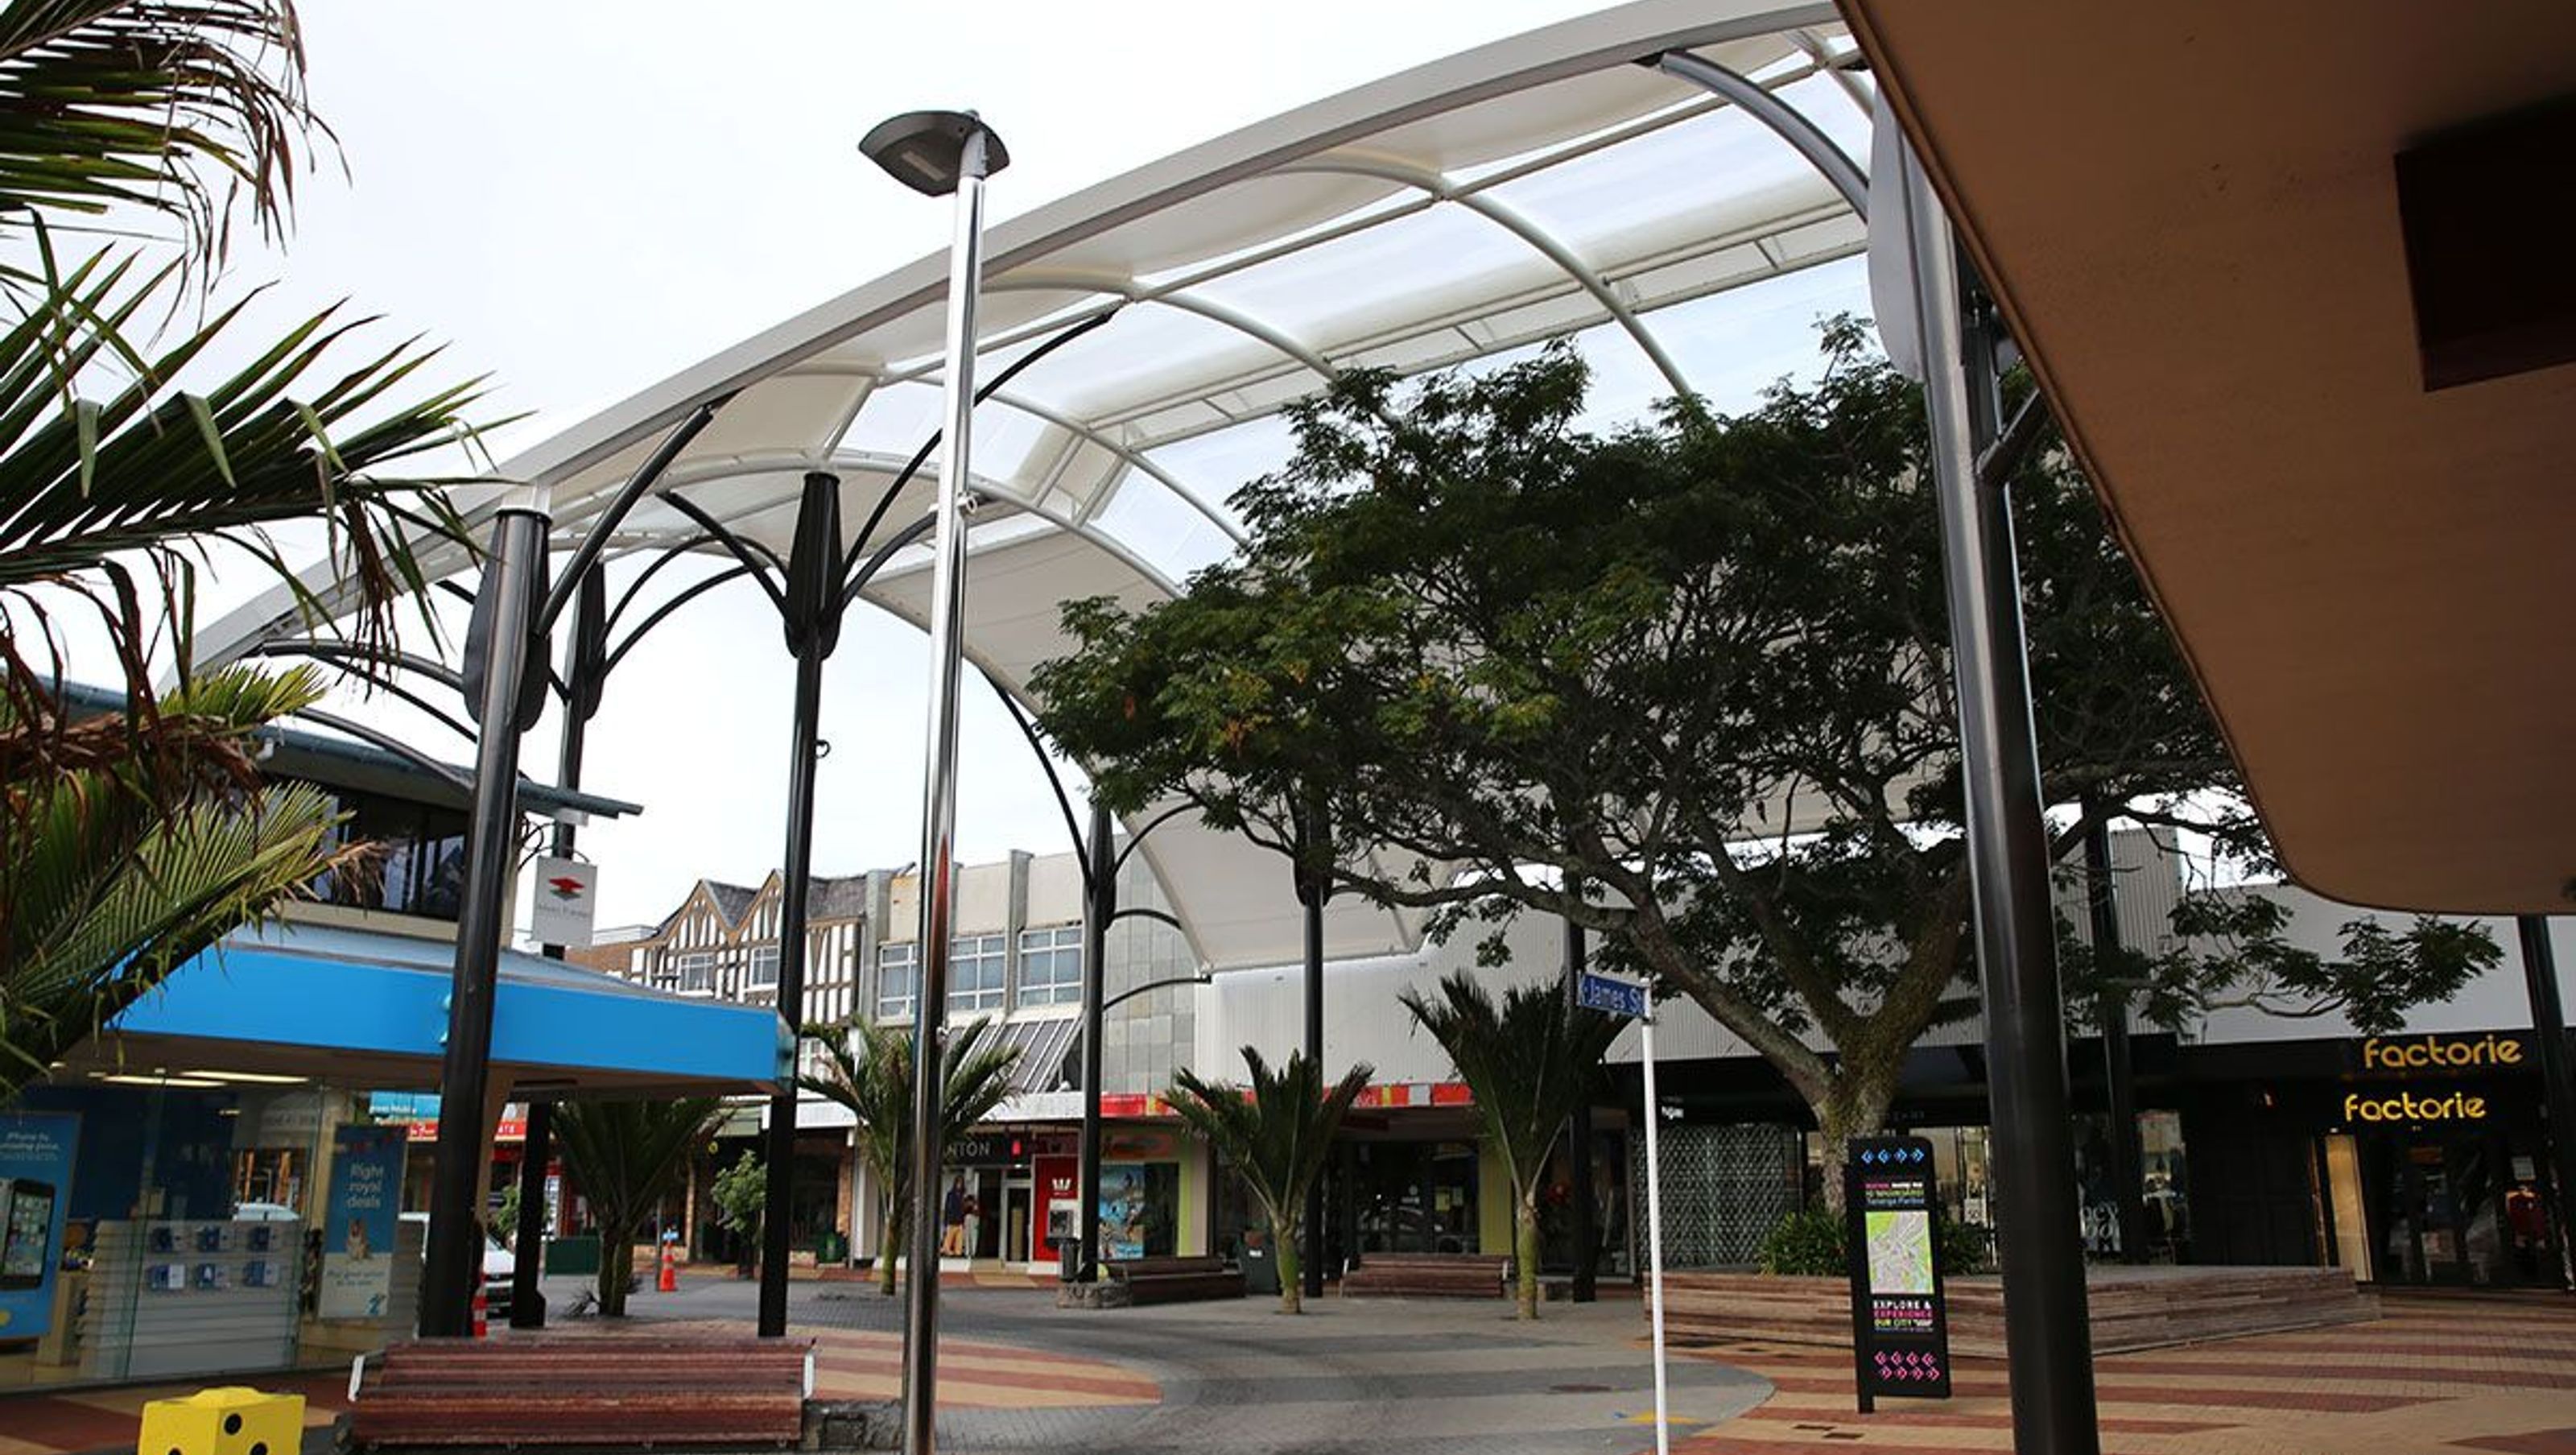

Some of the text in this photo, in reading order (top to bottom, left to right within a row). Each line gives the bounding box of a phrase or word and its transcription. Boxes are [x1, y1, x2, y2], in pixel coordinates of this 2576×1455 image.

[1587, 977, 1626, 1010] James
[2363, 1034, 2523, 1069] factorie
[2344, 1091, 2487, 1122] factorie
[350, 1163, 384, 1180] Right
[349, 1181, 382, 1196] royal
[346, 1196, 381, 1209] deals
[1873, 1300, 1920, 1310] EXPLORE
